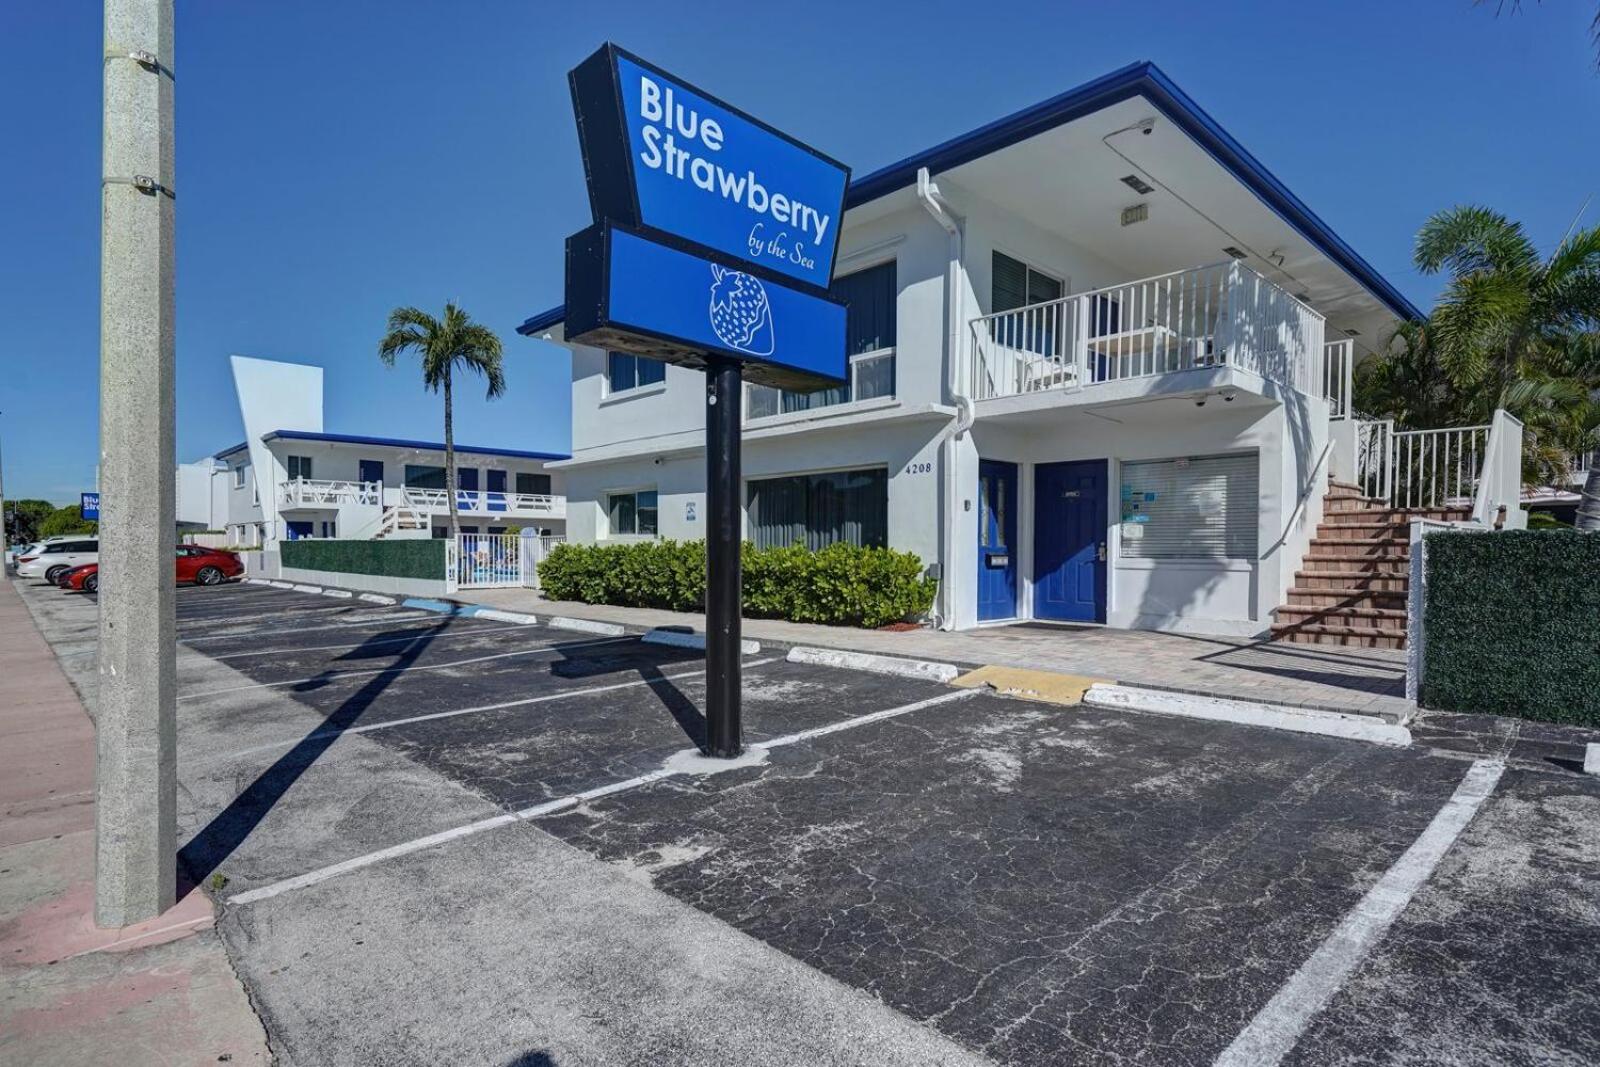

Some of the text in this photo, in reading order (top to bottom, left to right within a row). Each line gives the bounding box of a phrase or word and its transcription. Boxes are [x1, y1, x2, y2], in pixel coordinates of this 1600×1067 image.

[641, 75, 724, 151] Blue
[640, 124, 830, 246] Strawberry
[748, 222, 815, 270] by the Sea
[905, 462, 931, 474] 4208
